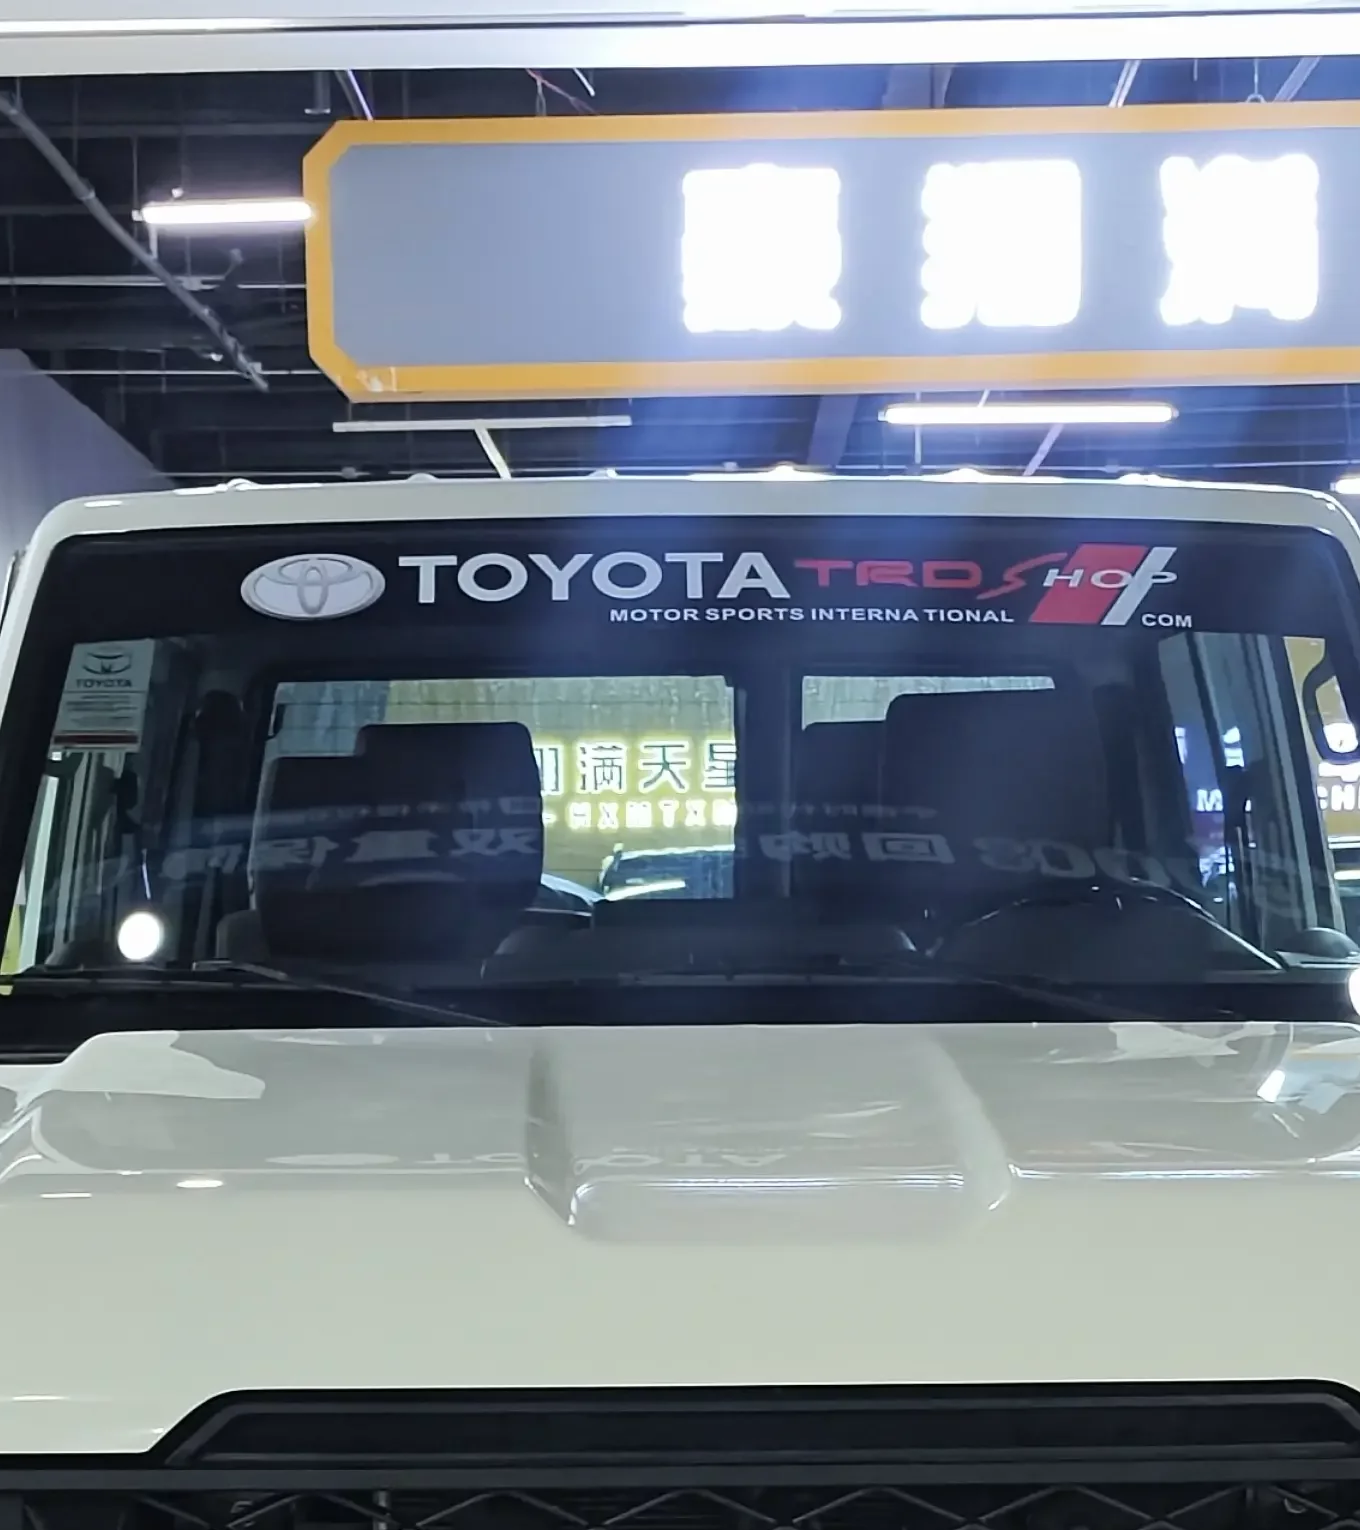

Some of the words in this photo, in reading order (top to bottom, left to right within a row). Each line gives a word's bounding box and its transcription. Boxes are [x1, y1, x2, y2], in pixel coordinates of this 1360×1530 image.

[398, 552, 791, 603] TOYOTA
[609, 608, 700, 622] MOTOR
[705, 607, 805, 621] SPORTS
